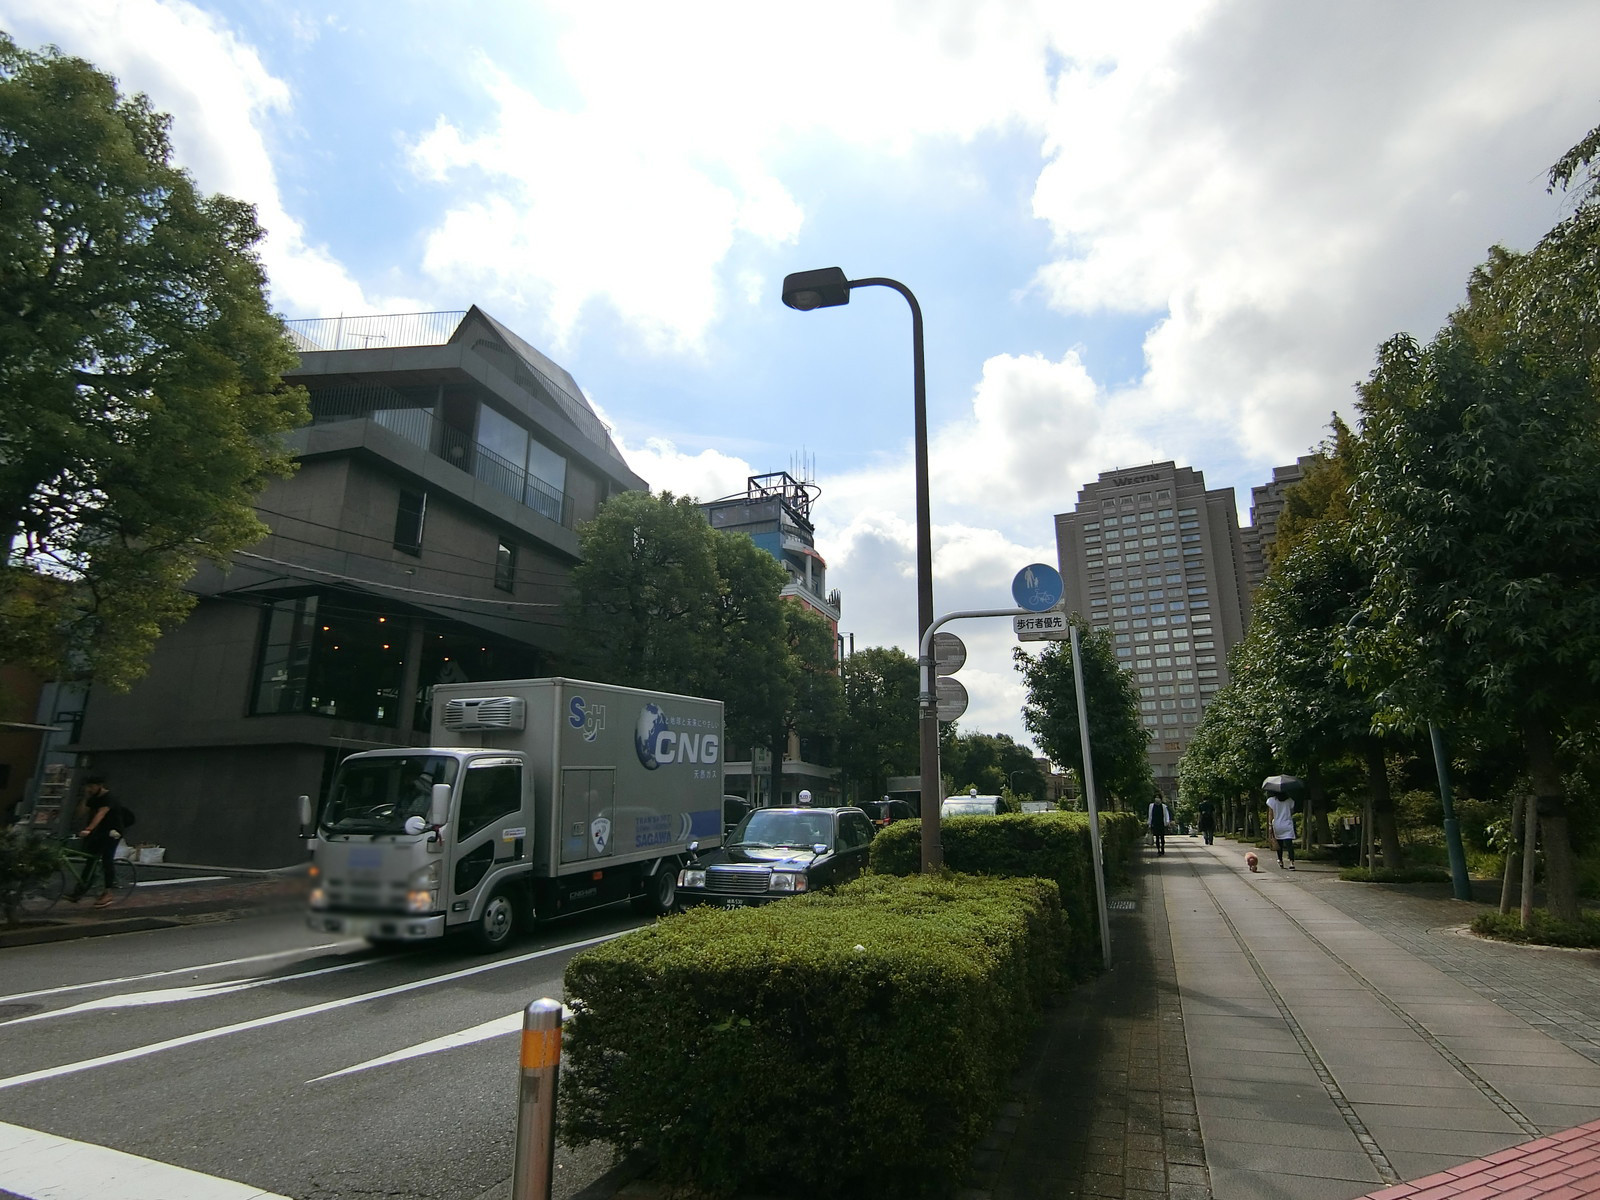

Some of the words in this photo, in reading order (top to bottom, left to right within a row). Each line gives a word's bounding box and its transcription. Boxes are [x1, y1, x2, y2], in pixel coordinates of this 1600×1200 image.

[1016, 617, 1062, 630] 歩行者優先
[654, 730, 719, 765] CNG
[635, 831, 672, 848] SAGAWA
